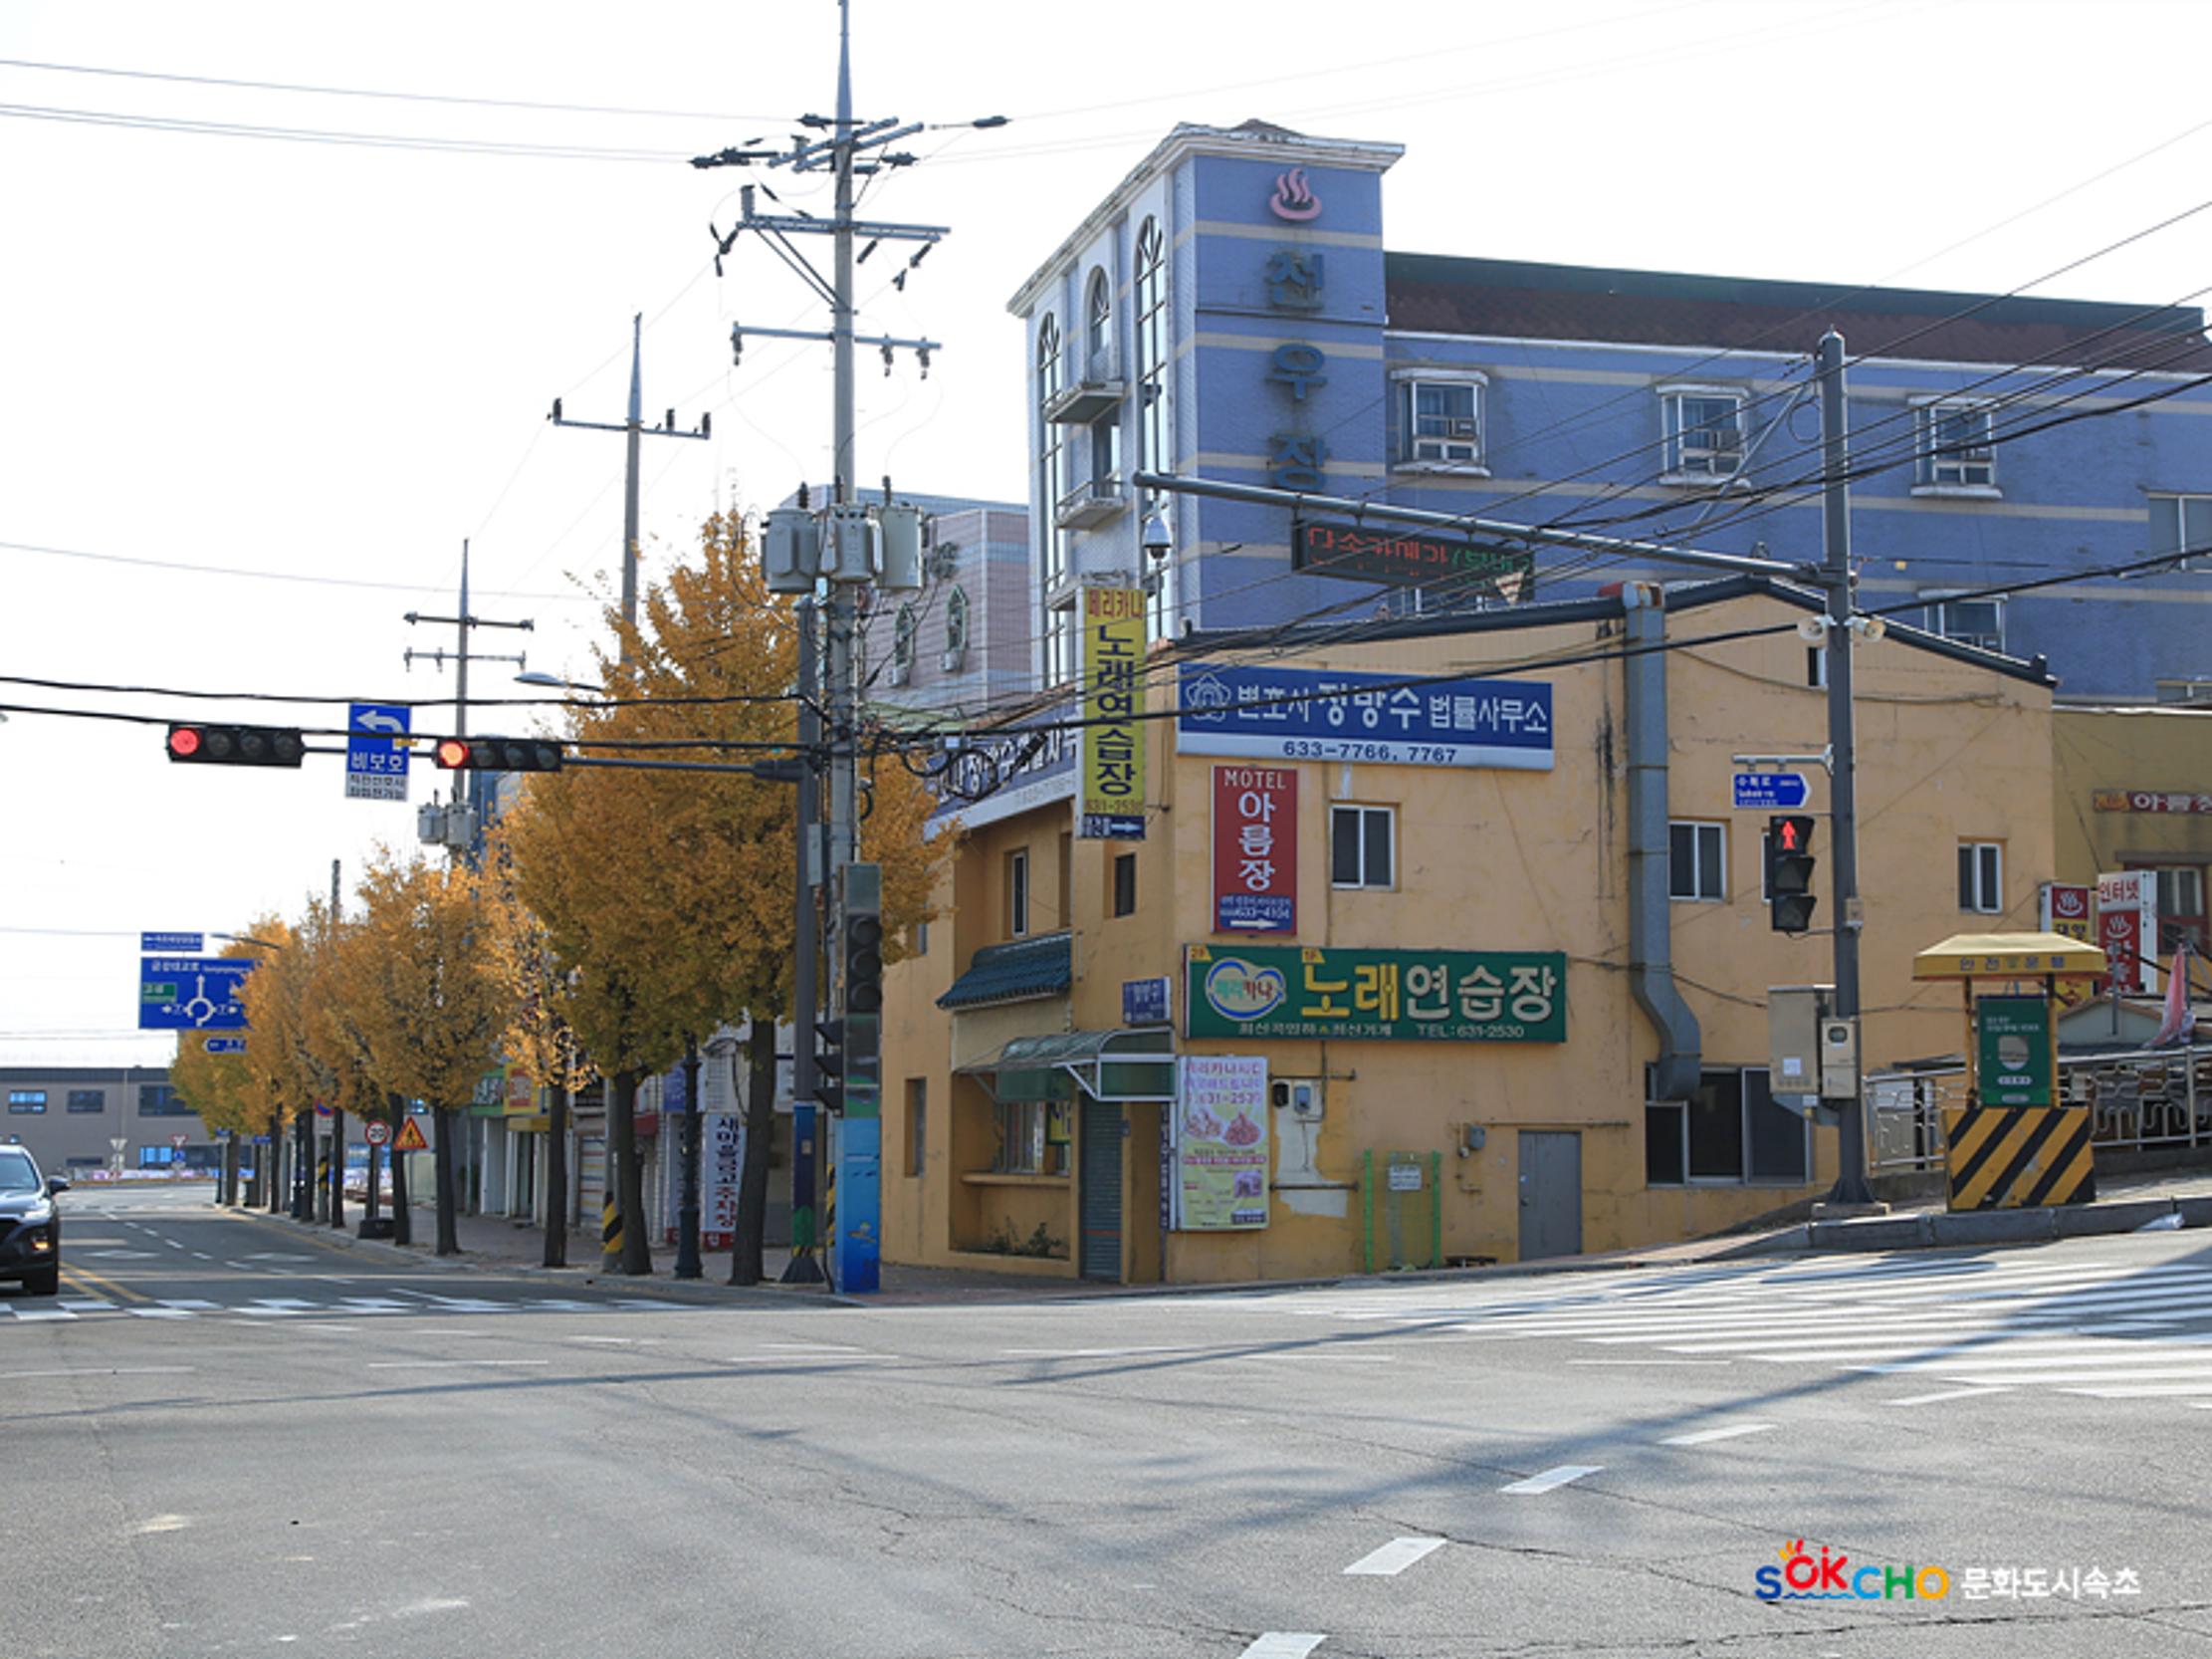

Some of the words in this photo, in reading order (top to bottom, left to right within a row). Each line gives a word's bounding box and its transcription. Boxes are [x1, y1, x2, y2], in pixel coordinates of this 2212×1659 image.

[1096, 624, 1136, 796] 노래연습장
[1237, 685, 1310, 723] 변호사
[1429, 694, 1548, 732] 법률사무소
[351, 752, 405, 773] 비보호
[1408, 746, 1458, 763] 7767
[1223, 769, 1288, 790] MOTEL
[1237, 792, 1276, 892] 아름장
[2098, 879, 2139, 903] 인터넷
[1301, 963, 1558, 1023] 노래연습장
